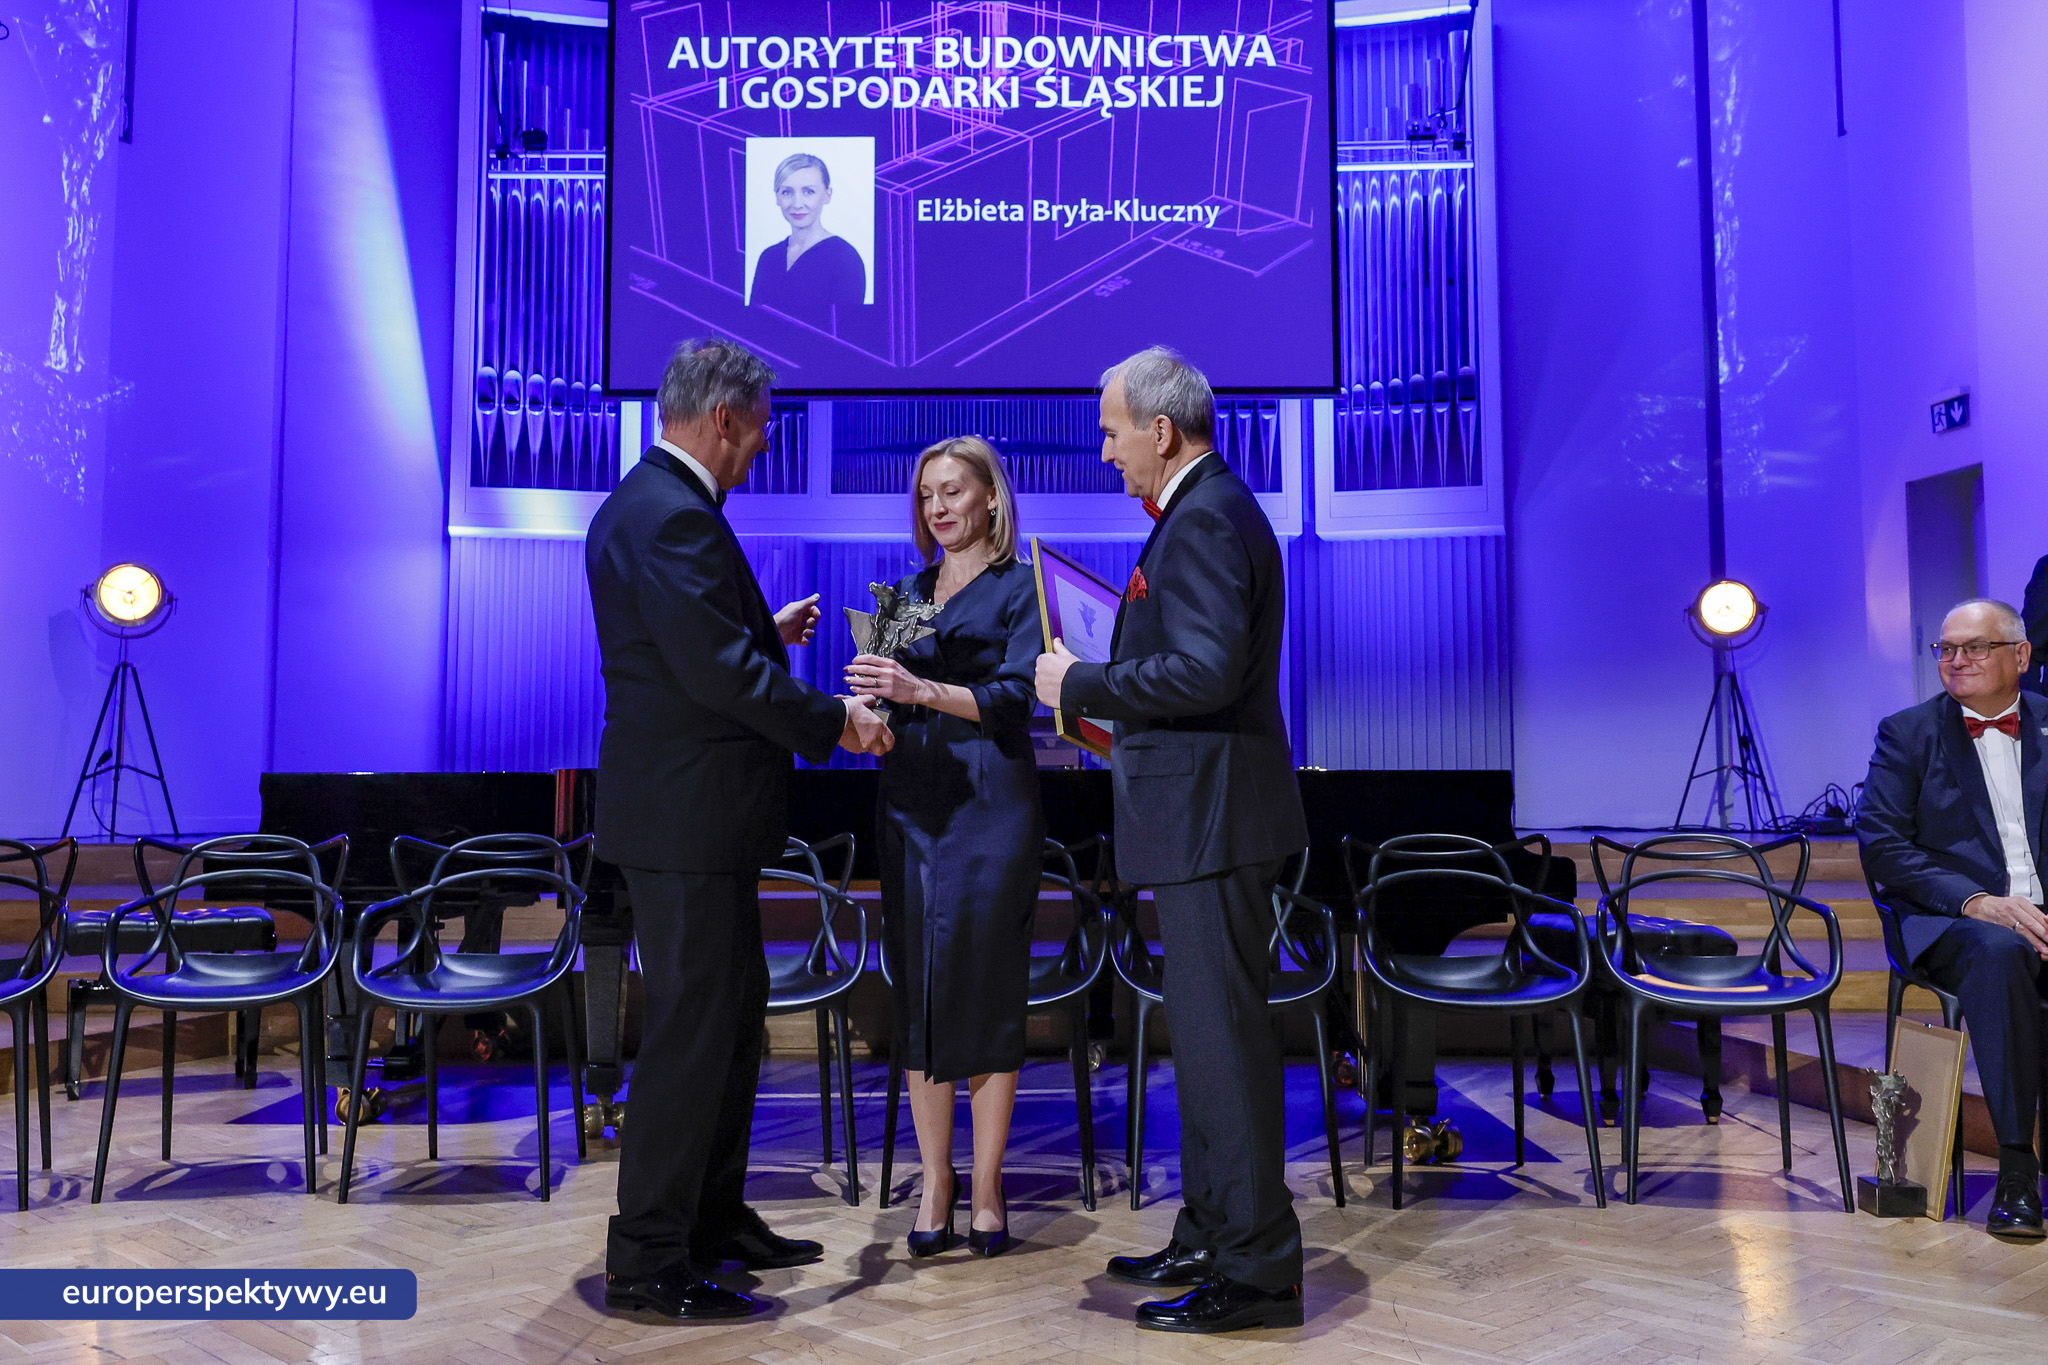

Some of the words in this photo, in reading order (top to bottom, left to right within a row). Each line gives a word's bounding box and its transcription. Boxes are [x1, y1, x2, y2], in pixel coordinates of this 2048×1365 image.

[668, 37, 923, 71] AUTORYTET
[932, 35, 1277, 70] BUDOWNICTWA
[718, 77, 728, 109] I
[742, 75, 1019, 109] GOSPODARKI
[1034, 68, 1225, 118] ŚLĄSKIEJ
[917, 197, 1025, 222] Elżbieta
[1033, 198, 1220, 229] Bryła-Kluczny
